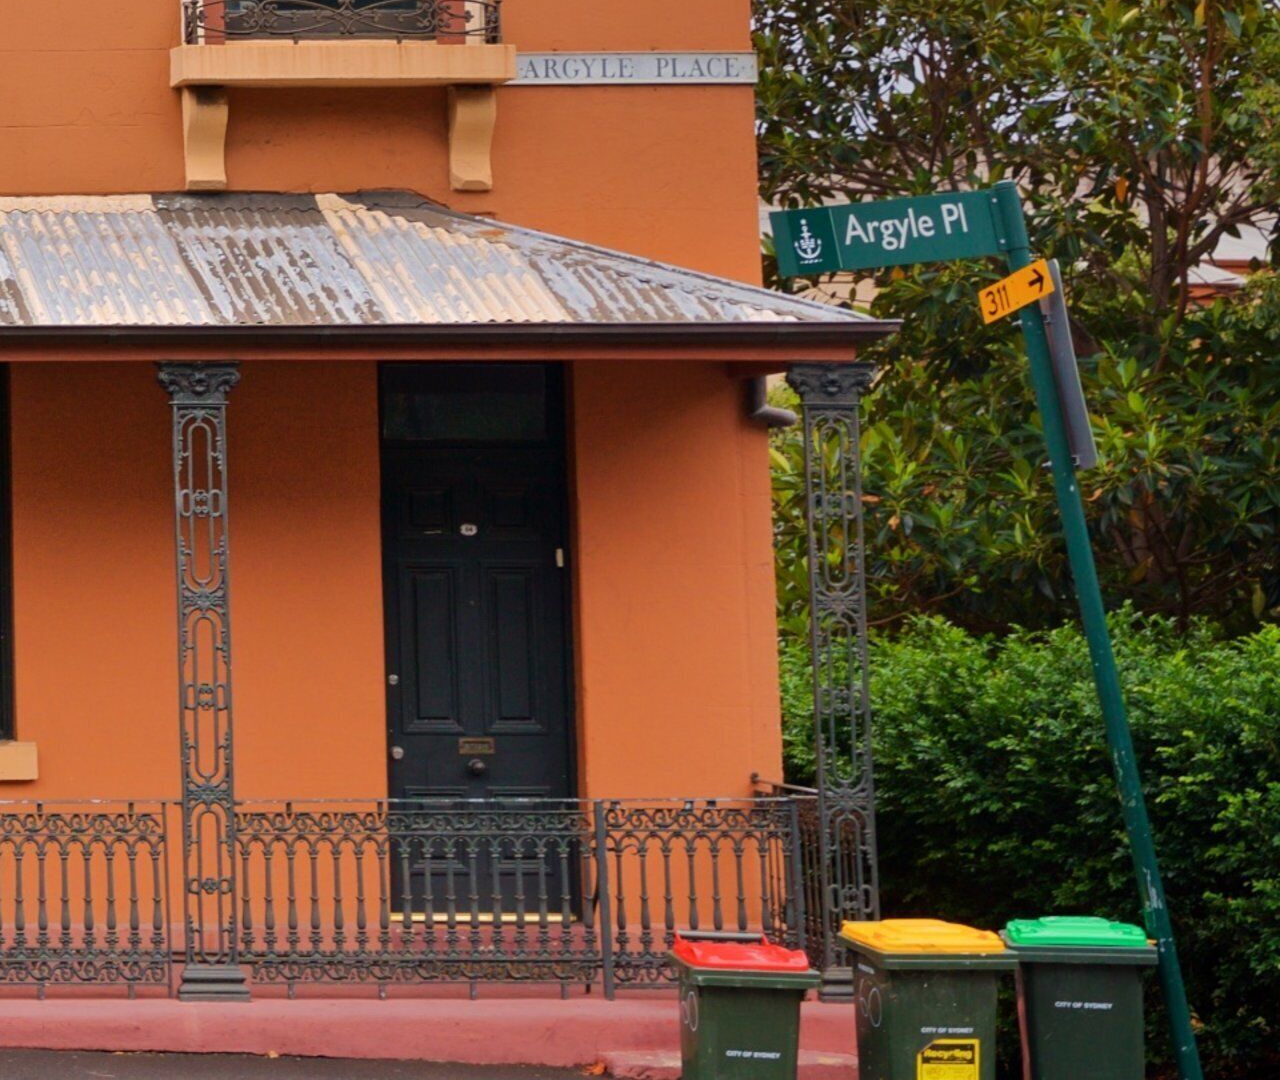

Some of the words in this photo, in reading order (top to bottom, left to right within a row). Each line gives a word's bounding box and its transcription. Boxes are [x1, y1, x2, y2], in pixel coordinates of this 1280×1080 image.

[524, 57, 634, 79] ARGYLE
[656, 56, 740, 78] PLACE
[845, 207, 935, 251] Argyle
[941, 202, 969, 235] Pl
[984, 284, 1012, 316] 311
[1072, 1001, 1083, 1009] OF
[1084, 1002, 1113, 1011] SYDNEY
[921, 1026, 937, 1034] CITY
[937, 1026, 947, 1034] OF
[742, 1050, 753, 1058] OF
[753, 1051, 781, 1059] SYDNEY
[923, 1049, 972, 1060] Recycling
